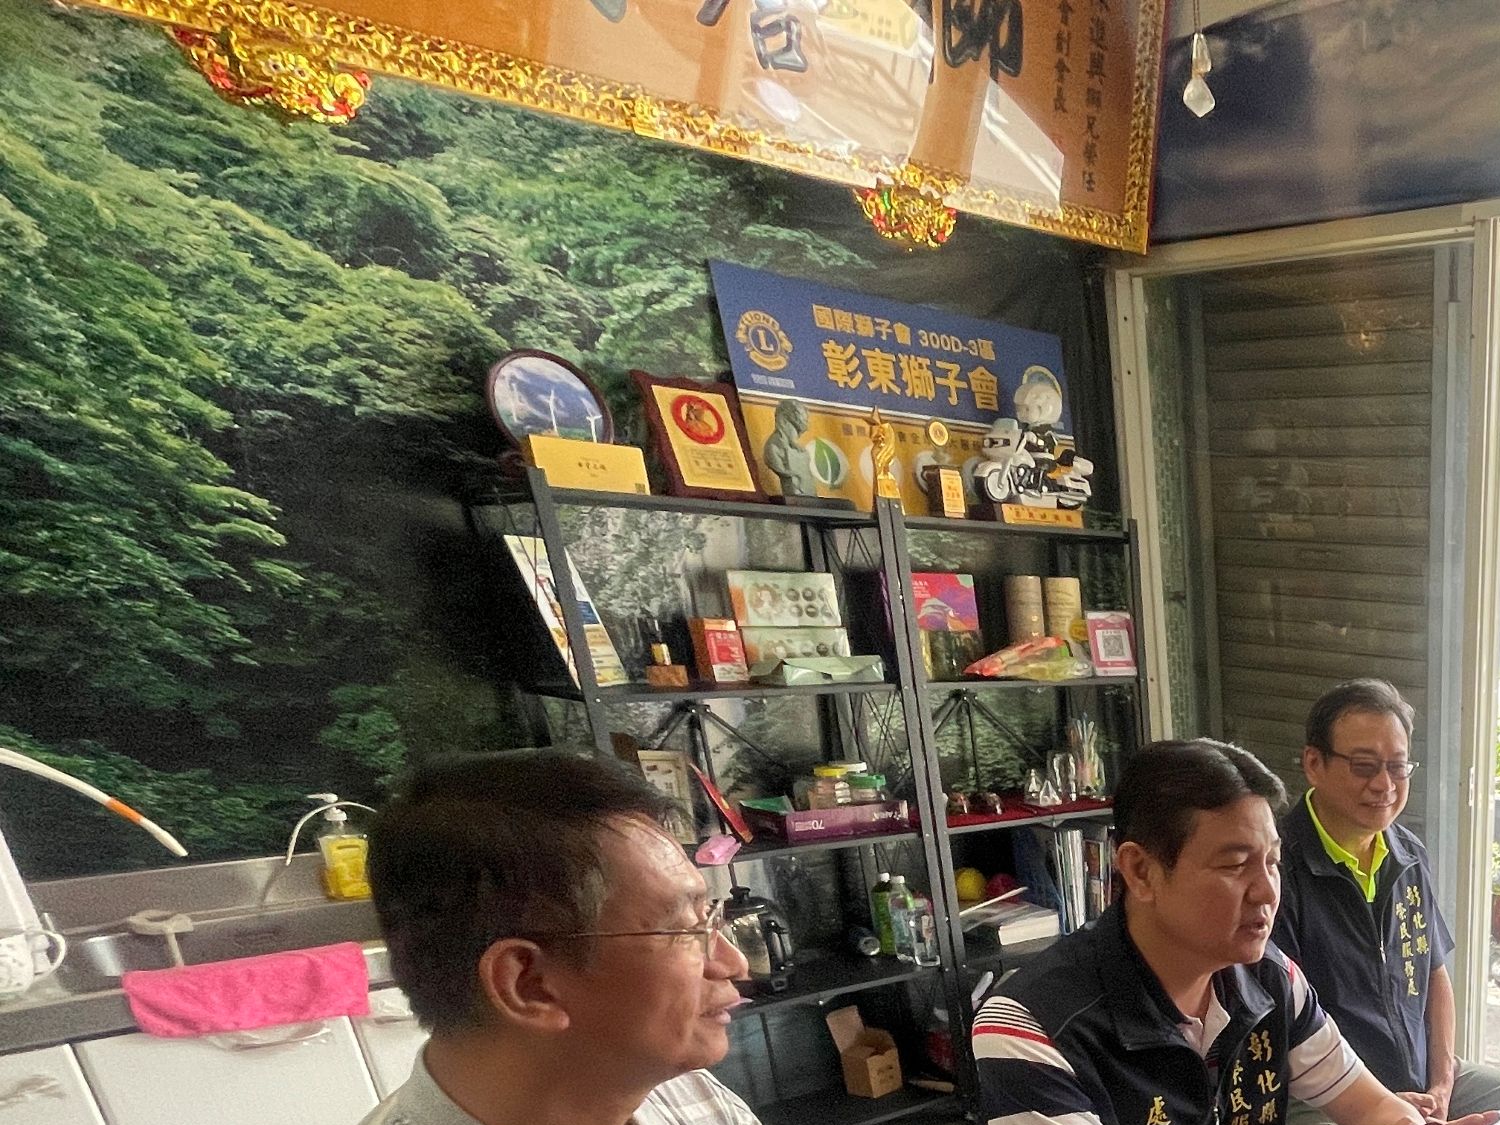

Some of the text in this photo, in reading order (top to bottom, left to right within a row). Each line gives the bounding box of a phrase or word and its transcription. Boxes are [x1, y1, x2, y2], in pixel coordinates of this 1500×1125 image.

[812, 304, 996, 361] 國際獅子會 300D-3區
[821, 339, 1000, 412] 彰東獅子會
[1405, 885, 1430, 955] 彰化縣
[1247, 1030, 1281, 1125] 彰化縣
